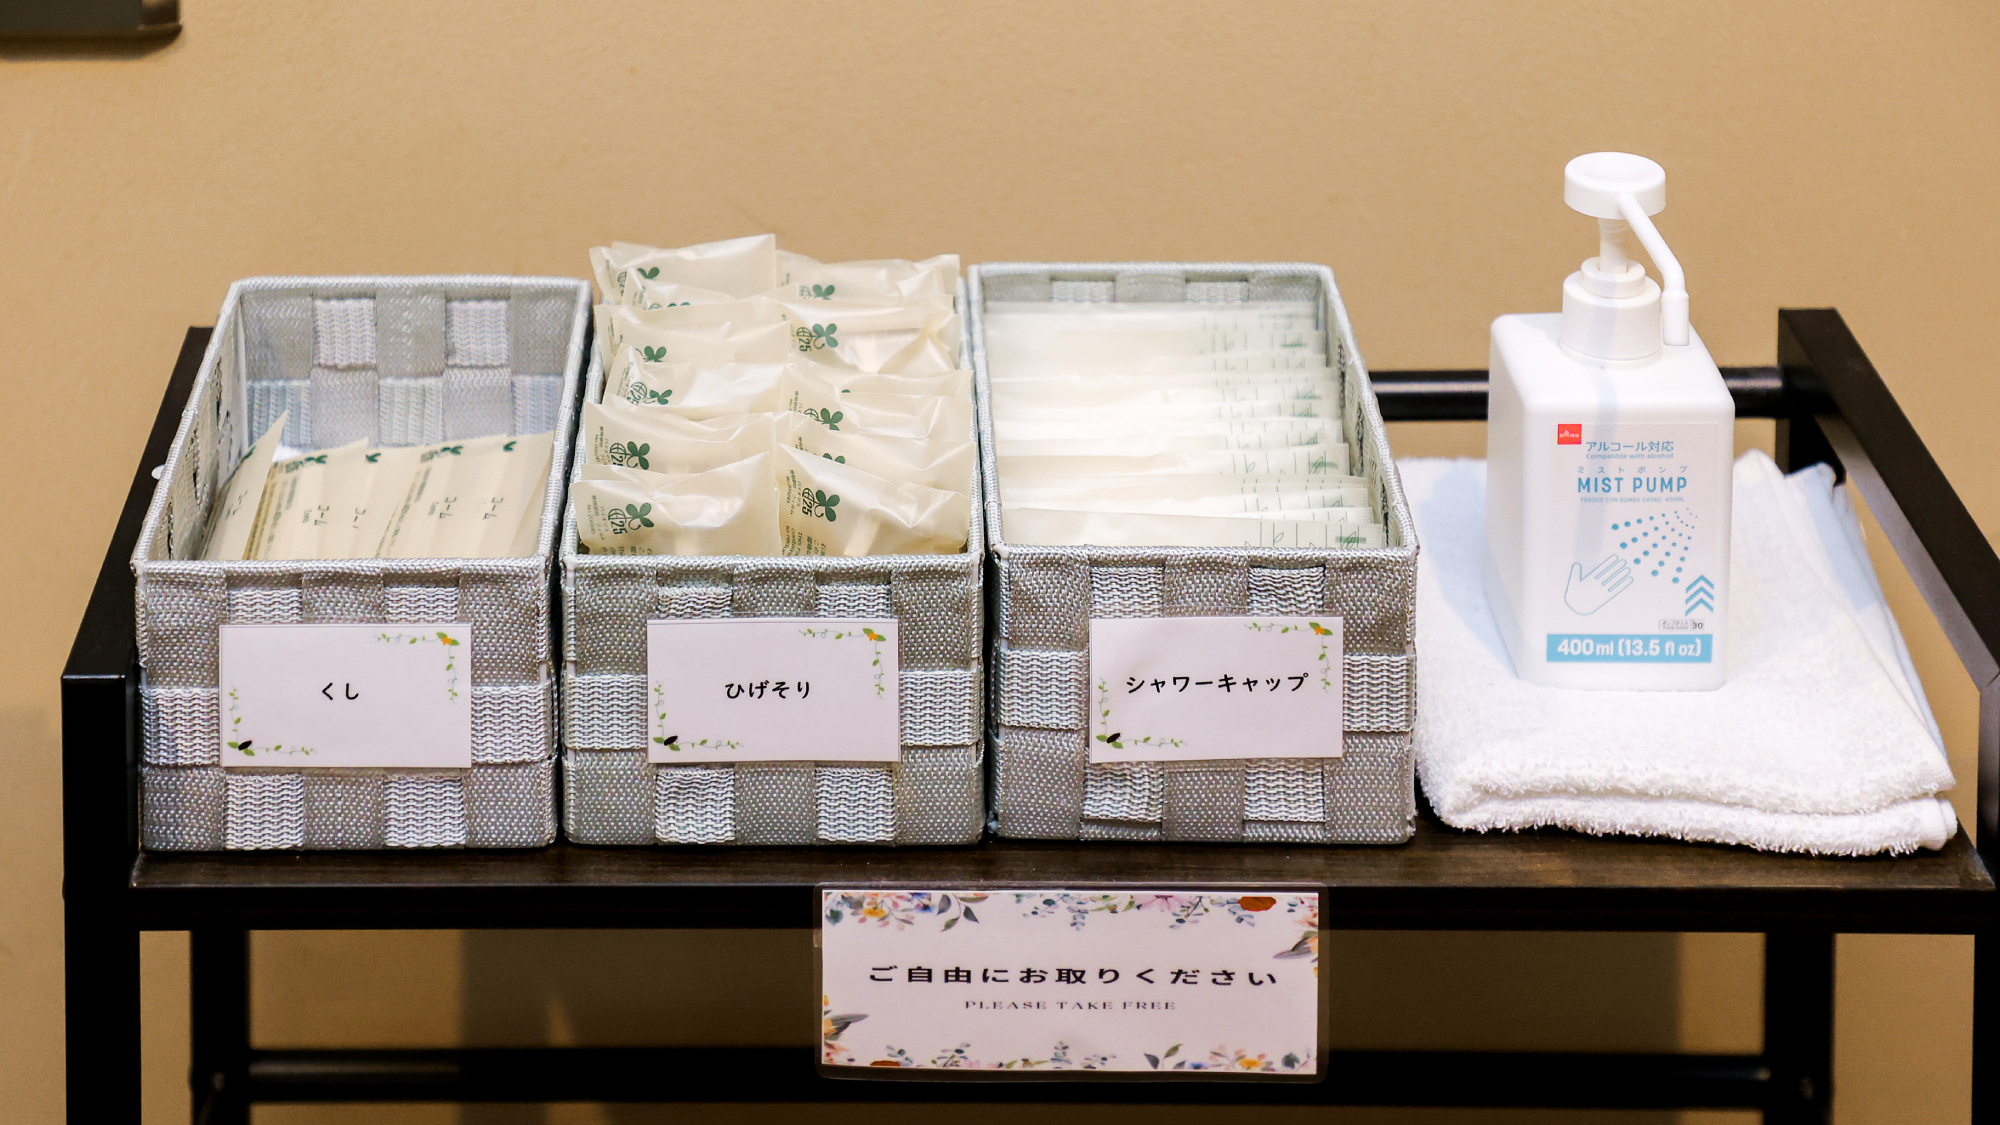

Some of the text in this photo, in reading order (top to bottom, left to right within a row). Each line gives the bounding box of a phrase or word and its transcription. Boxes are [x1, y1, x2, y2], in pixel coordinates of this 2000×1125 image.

[1585, 441, 1674, 452] アルコール対応
[1577, 477, 1688, 493] MIST PUMP
[802, 498, 813, 517] 25
[610, 520, 628, 535] 25
[1618, 638, 1660, 657] (13.5
[1678, 638, 1702, 657] oz)
[322, 682, 359, 701] くし
[725, 679, 811, 700] ひげそり
[1126, 672, 1309, 694] シャワーキャップ
[868, 965, 1278, 986] ご自由にお取りください
[965, 1001, 1177, 1011] PLEASE TAKE FREE
